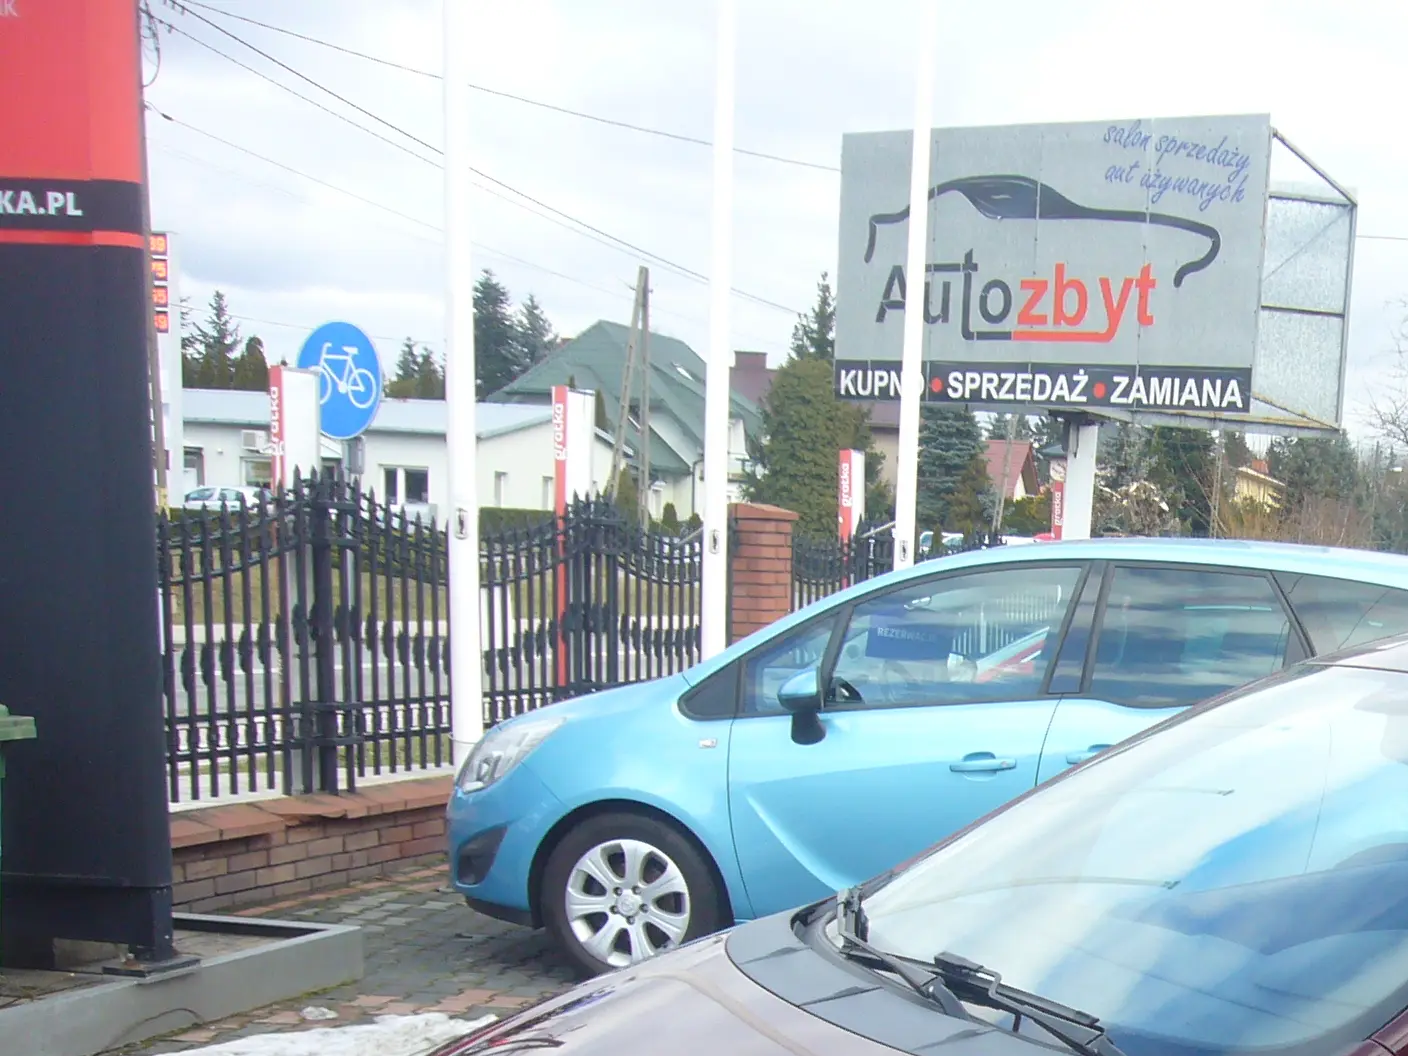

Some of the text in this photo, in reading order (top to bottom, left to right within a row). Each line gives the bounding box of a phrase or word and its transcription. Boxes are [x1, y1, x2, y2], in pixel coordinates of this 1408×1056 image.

[1103, 119, 1250, 184] salon sprzedaży
[1104, 160, 1140, 184] aut
[946, 368, 1088, 402] SPRZEDAŻ
[1110, 375, 1243, 408] ZAMIANA
[553, 403, 568, 461] gratka
